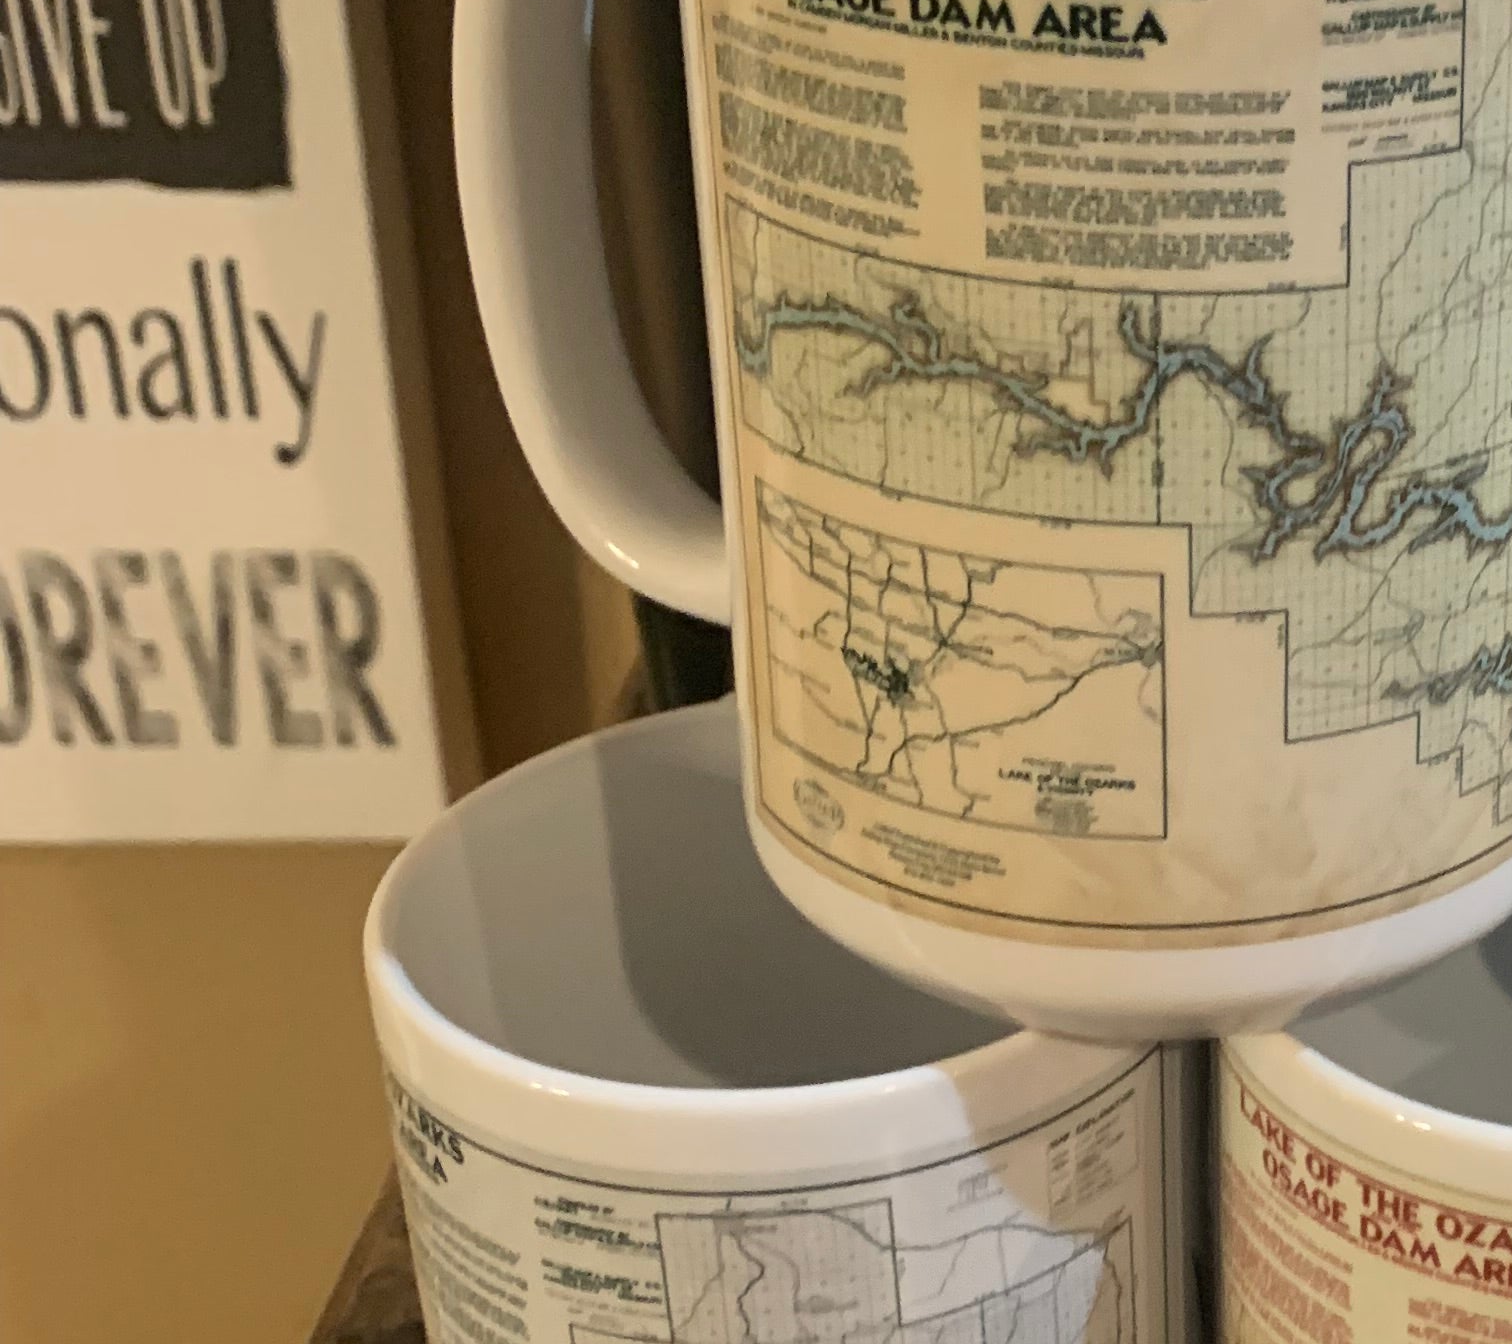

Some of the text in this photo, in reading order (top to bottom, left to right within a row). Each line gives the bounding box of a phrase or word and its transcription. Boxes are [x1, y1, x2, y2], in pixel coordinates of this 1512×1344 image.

[1032, 4, 1169, 46] AREA
[0, 253, 326, 469] onally
[1240, 1083, 1297, 1165] LAKE
[1305, 1153, 1342, 1188] OF
[1357, 1178, 1423, 1229] THE
[1262, 1148, 1350, 1230] OSAGE
[1360, 1214, 1441, 1269] DAM
